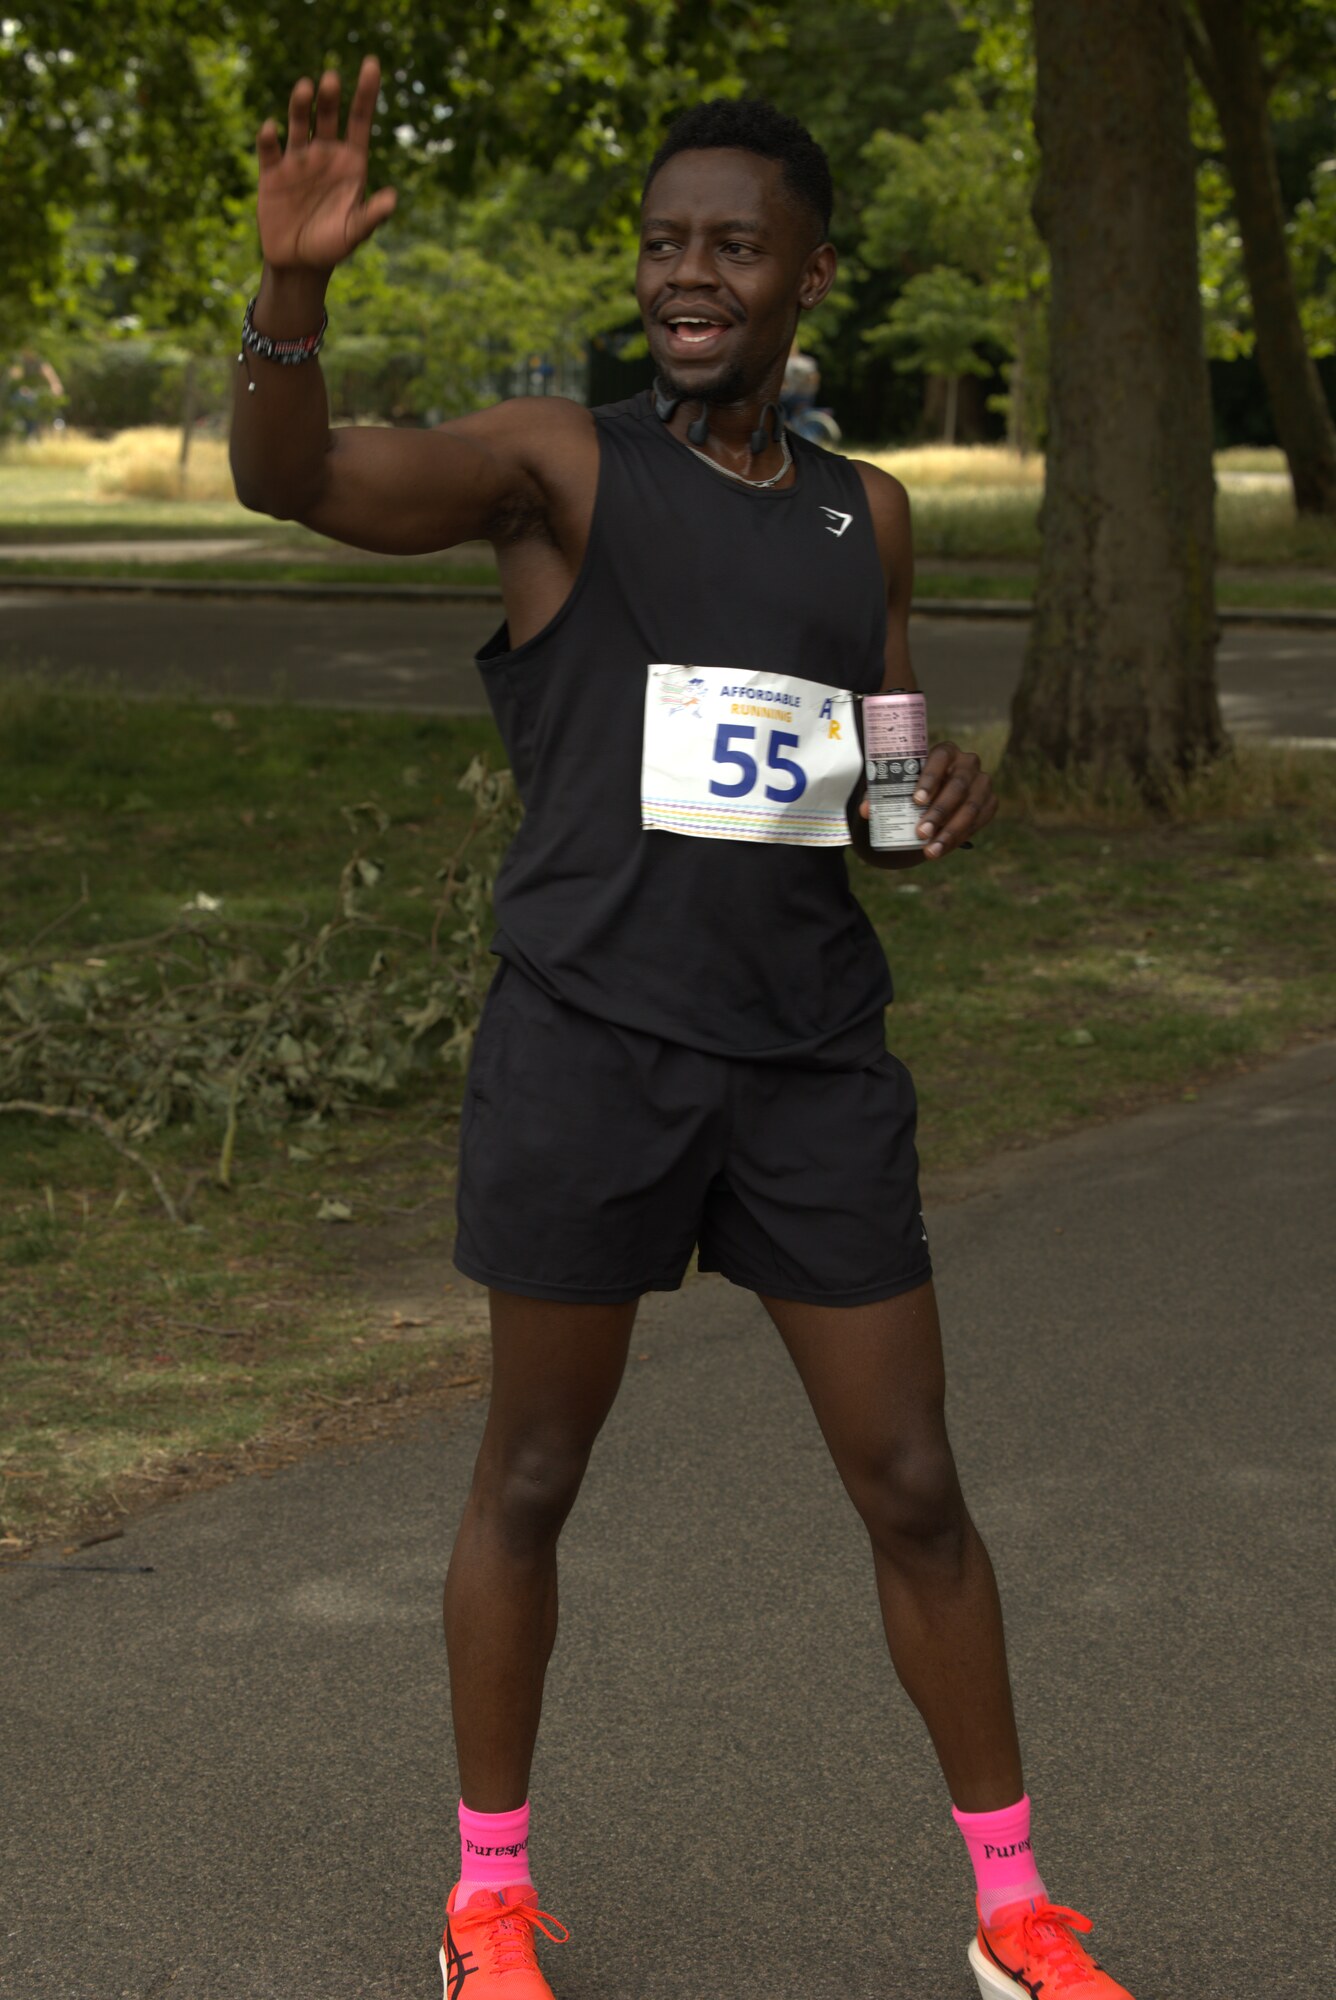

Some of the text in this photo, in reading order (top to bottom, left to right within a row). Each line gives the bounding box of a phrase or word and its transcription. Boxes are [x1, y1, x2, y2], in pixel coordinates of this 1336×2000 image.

[720, 686, 801, 708] AFFORDABLE
[731, 703, 793, 723] RUNNING
[819, 698, 833, 720] A
[828, 720, 842, 740] R
[709, 723, 807, 804] 55
